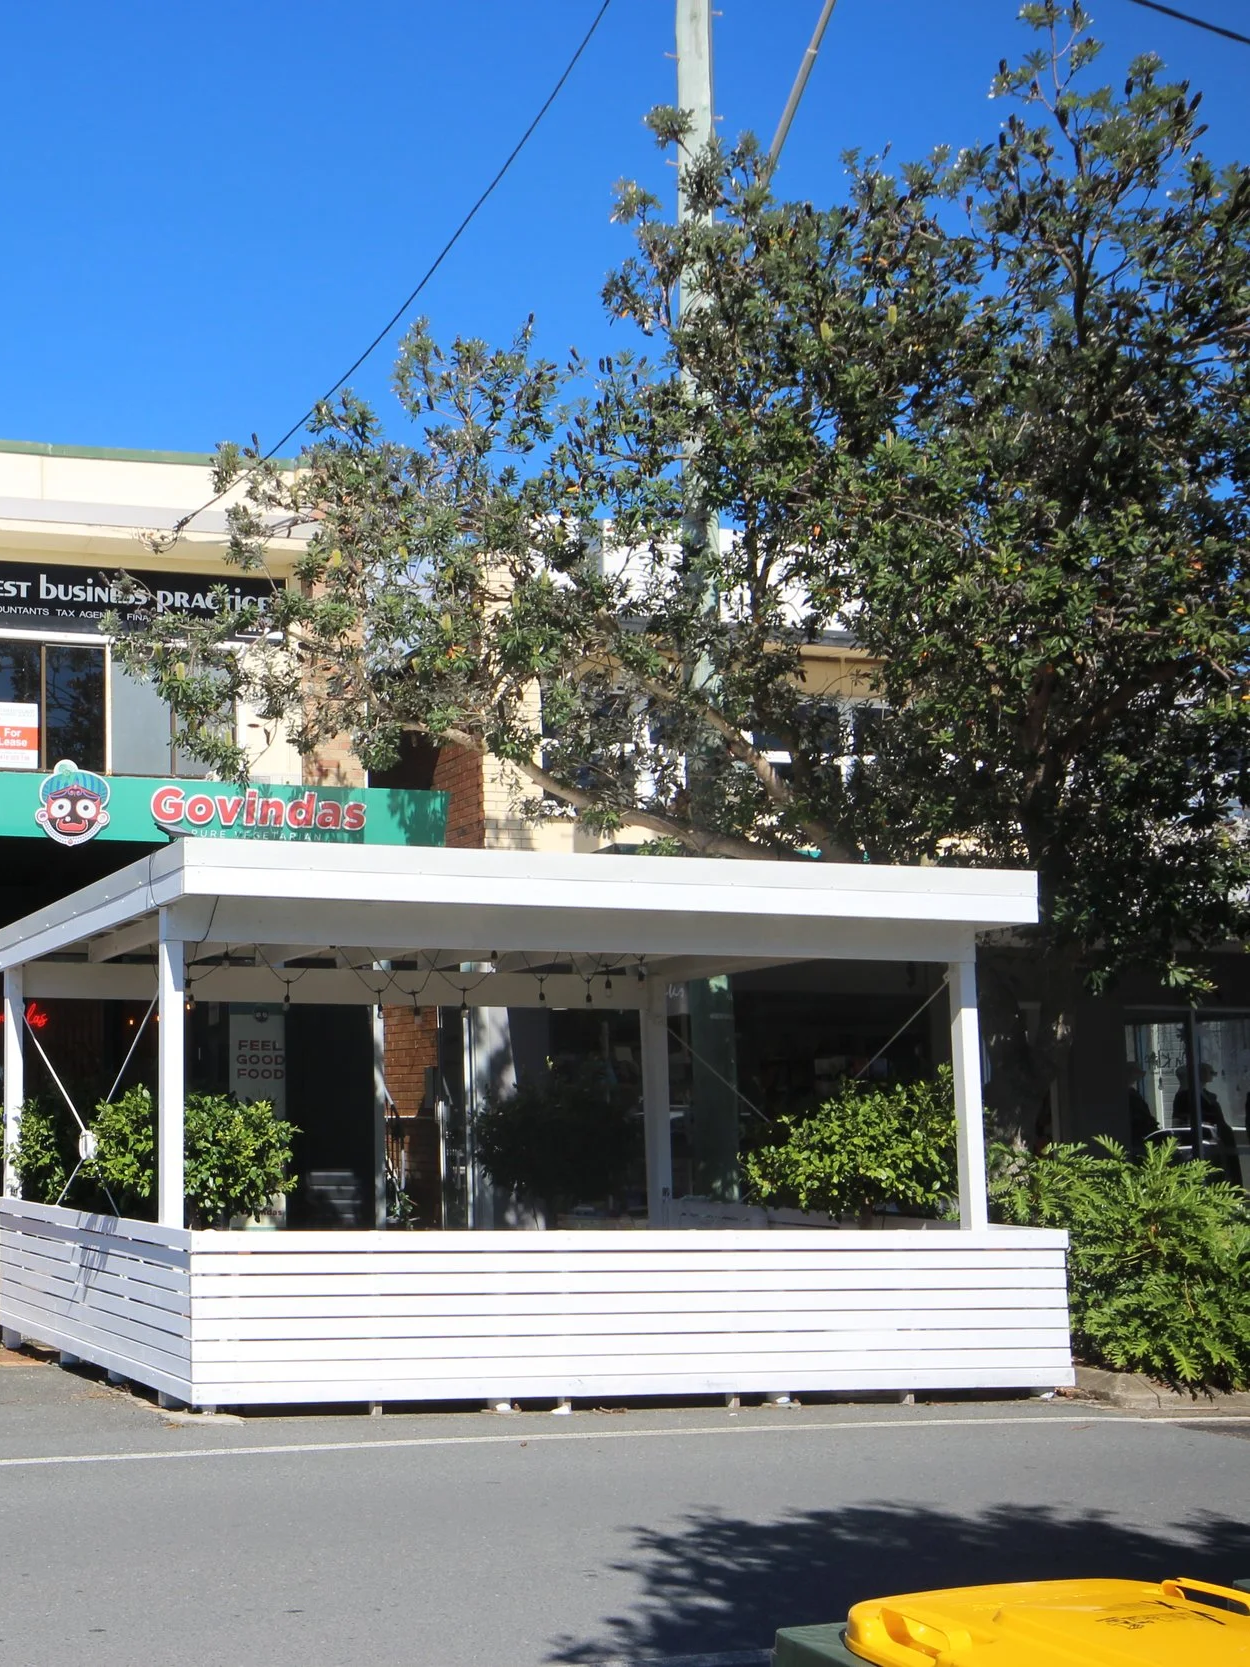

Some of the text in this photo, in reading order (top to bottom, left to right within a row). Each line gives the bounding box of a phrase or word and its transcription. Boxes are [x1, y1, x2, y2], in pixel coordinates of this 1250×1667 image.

[56, 608, 75, 618] TAX
[4, 728, 22, 738] For
[151, 786, 366, 830] Govindas
[191, 828, 323, 842] PURE VEGETARIAN
[238, 1040, 283, 1051] FEEL
[237, 1054, 285, 1066] GOOD
[237, 1068, 284, 1079] FOOD
